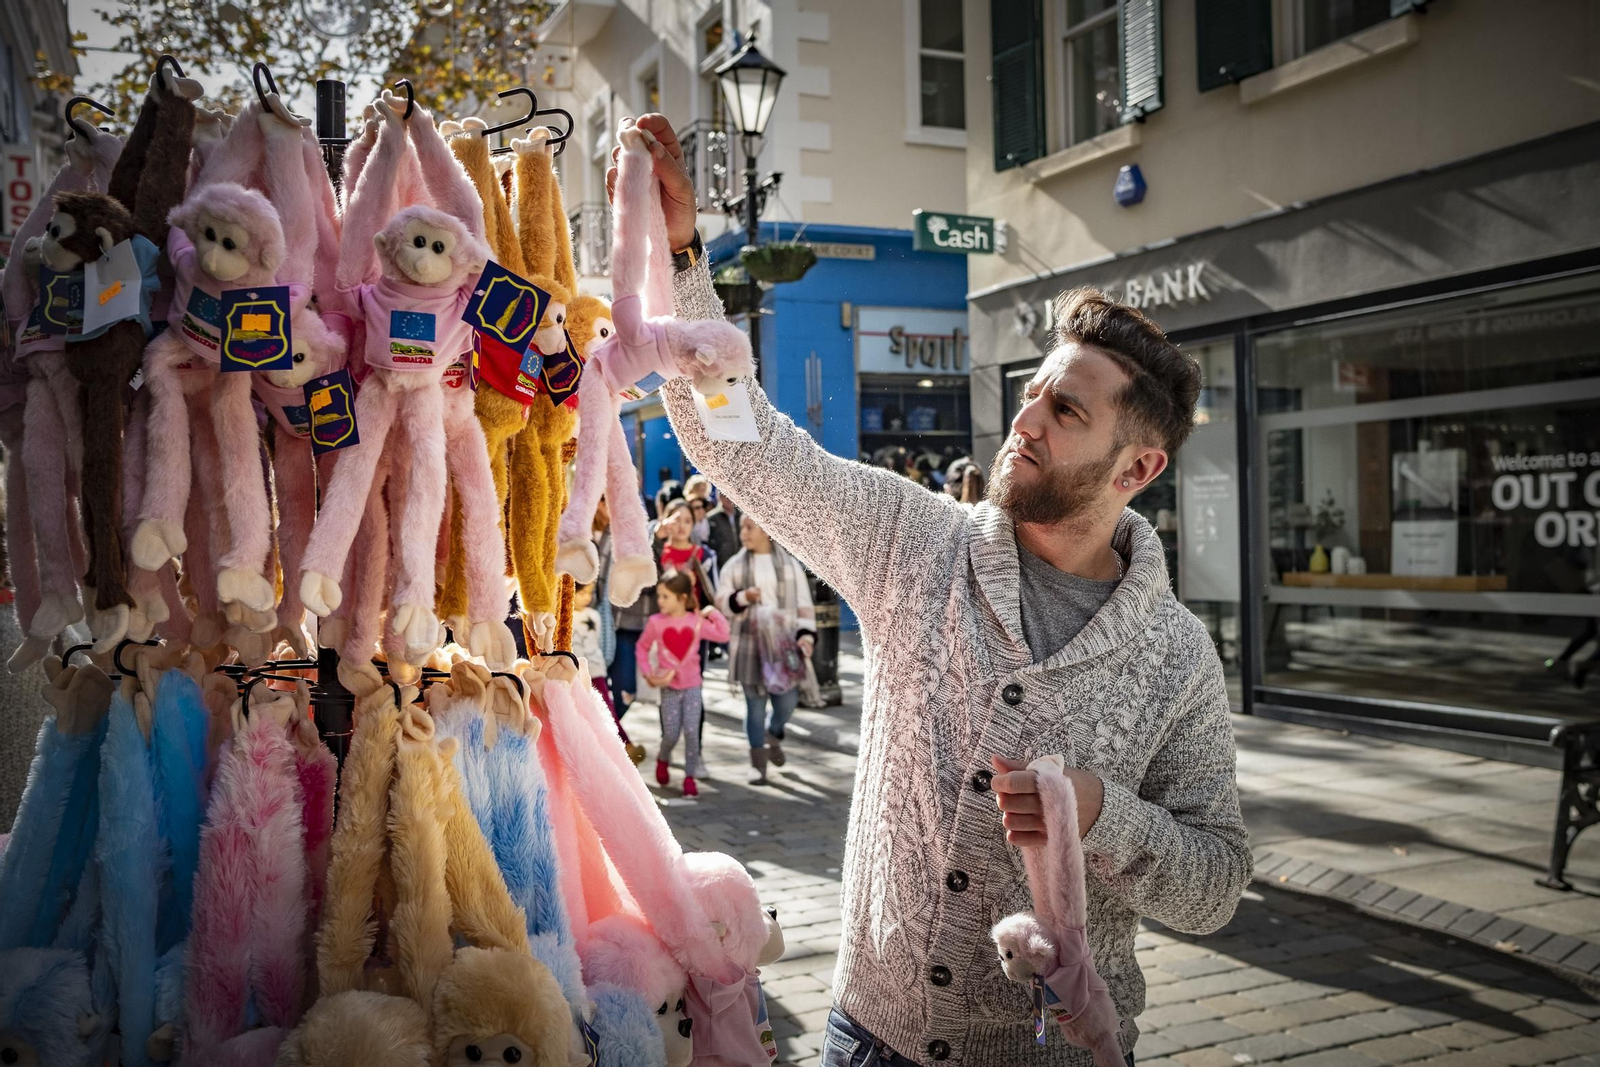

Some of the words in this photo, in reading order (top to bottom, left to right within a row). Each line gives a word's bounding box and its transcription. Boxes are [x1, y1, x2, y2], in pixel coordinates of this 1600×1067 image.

[933, 226, 989, 250] Cash
[1126, 263, 1207, 308] BANK
[511, 298, 532, 336] GIBRALTAR
[1491, 453, 1566, 471] Welcome
[1567, 451, 1588, 467] to
[1491, 472, 1578, 510] OUT
[1534, 511, 1600, 548] OR
